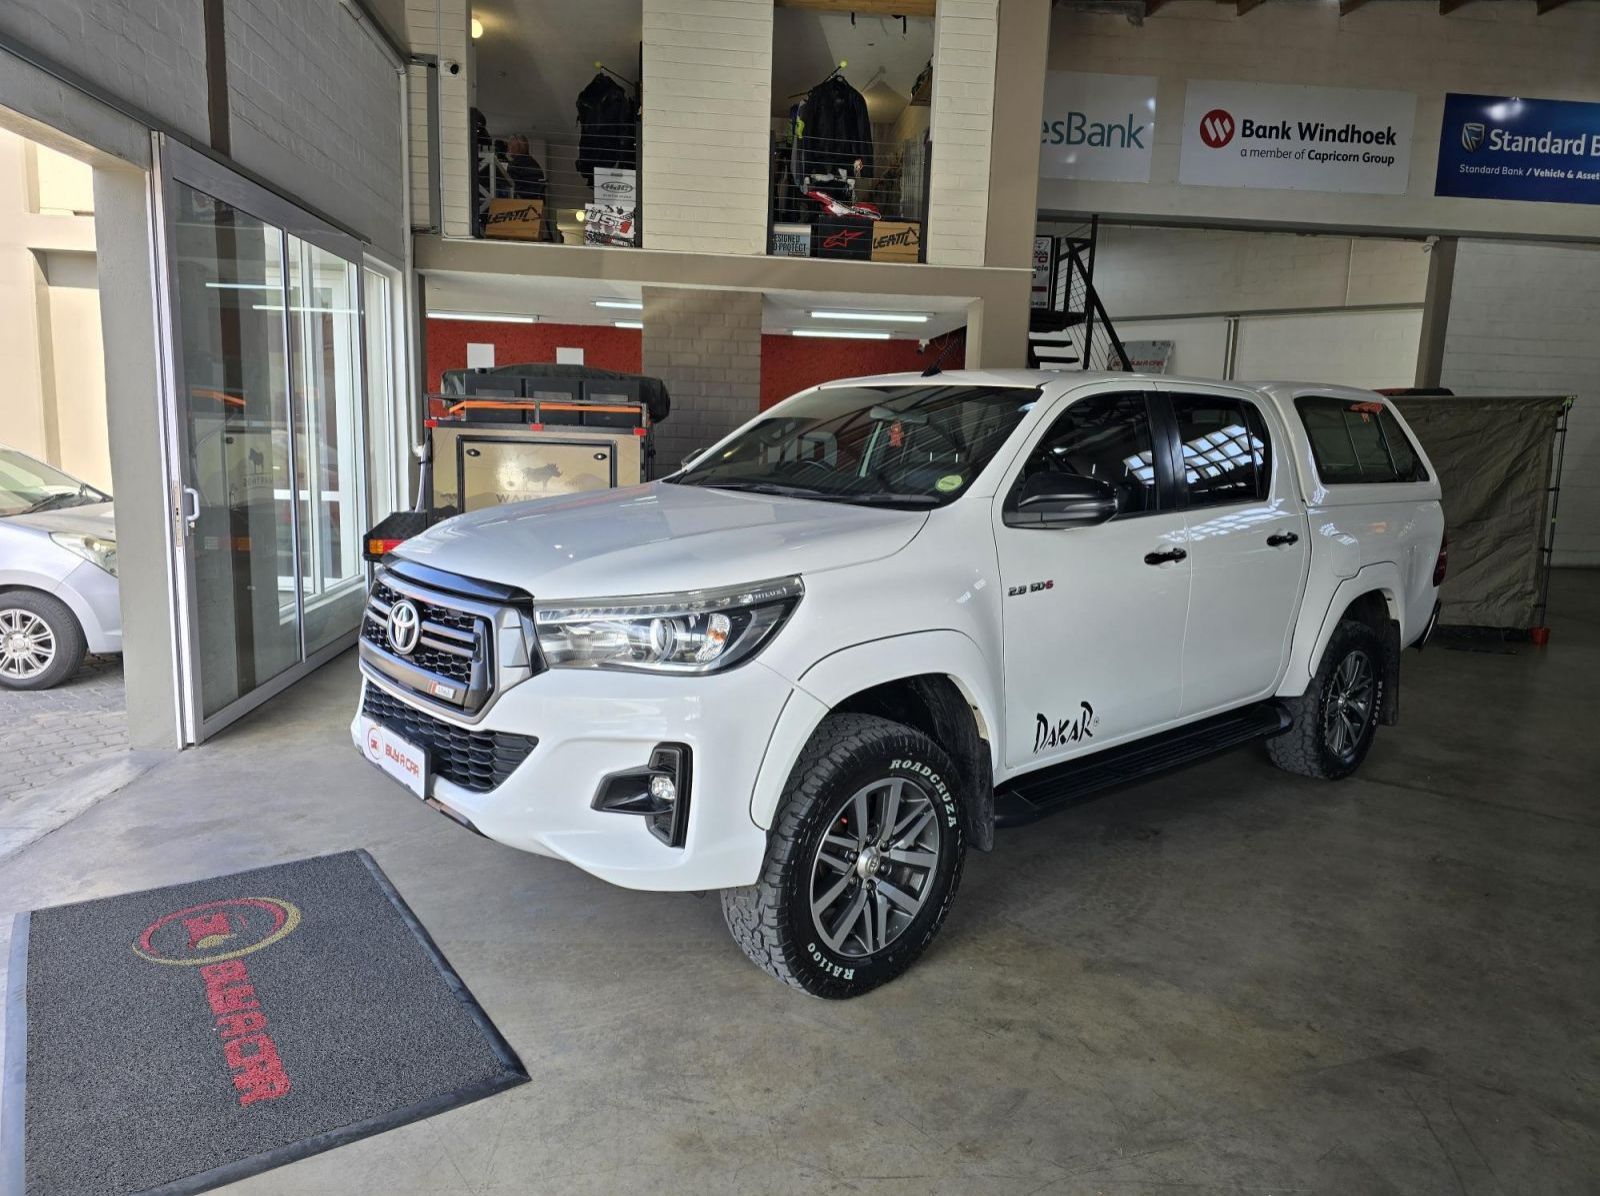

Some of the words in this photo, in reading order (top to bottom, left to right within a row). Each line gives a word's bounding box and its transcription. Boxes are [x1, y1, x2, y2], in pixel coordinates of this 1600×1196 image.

[1241, 119, 1292, 140] Bank
[1298, 122, 1397, 146] Windhoek
[1488, 129, 1586, 156] Standard
[1240, 148, 1247, 157] a
[1250, 148, 1292, 160] member
[1294, 149, 1306, 160] of
[1307, 149, 1359, 163] Capricorn
[1362, 152, 1395, 166] Group
[1460, 164, 1500, 175] Standard
[1502, 166, 1524, 176] Bank
[1533, 168, 1565, 179] Vehicle
[1567, 170, 1574, 179] &
[1576, 170, 1600, 180] Asset
[1008, 585, 1027, 597] 2.8
[1033, 701, 1094, 754] DAKAR
[385, 743, 400, 763] BUY
[405, 758, 420, 779] CAR
[890, 759, 957, 828] ROADCRUZA
[807, 942, 855, 980] RA1100
